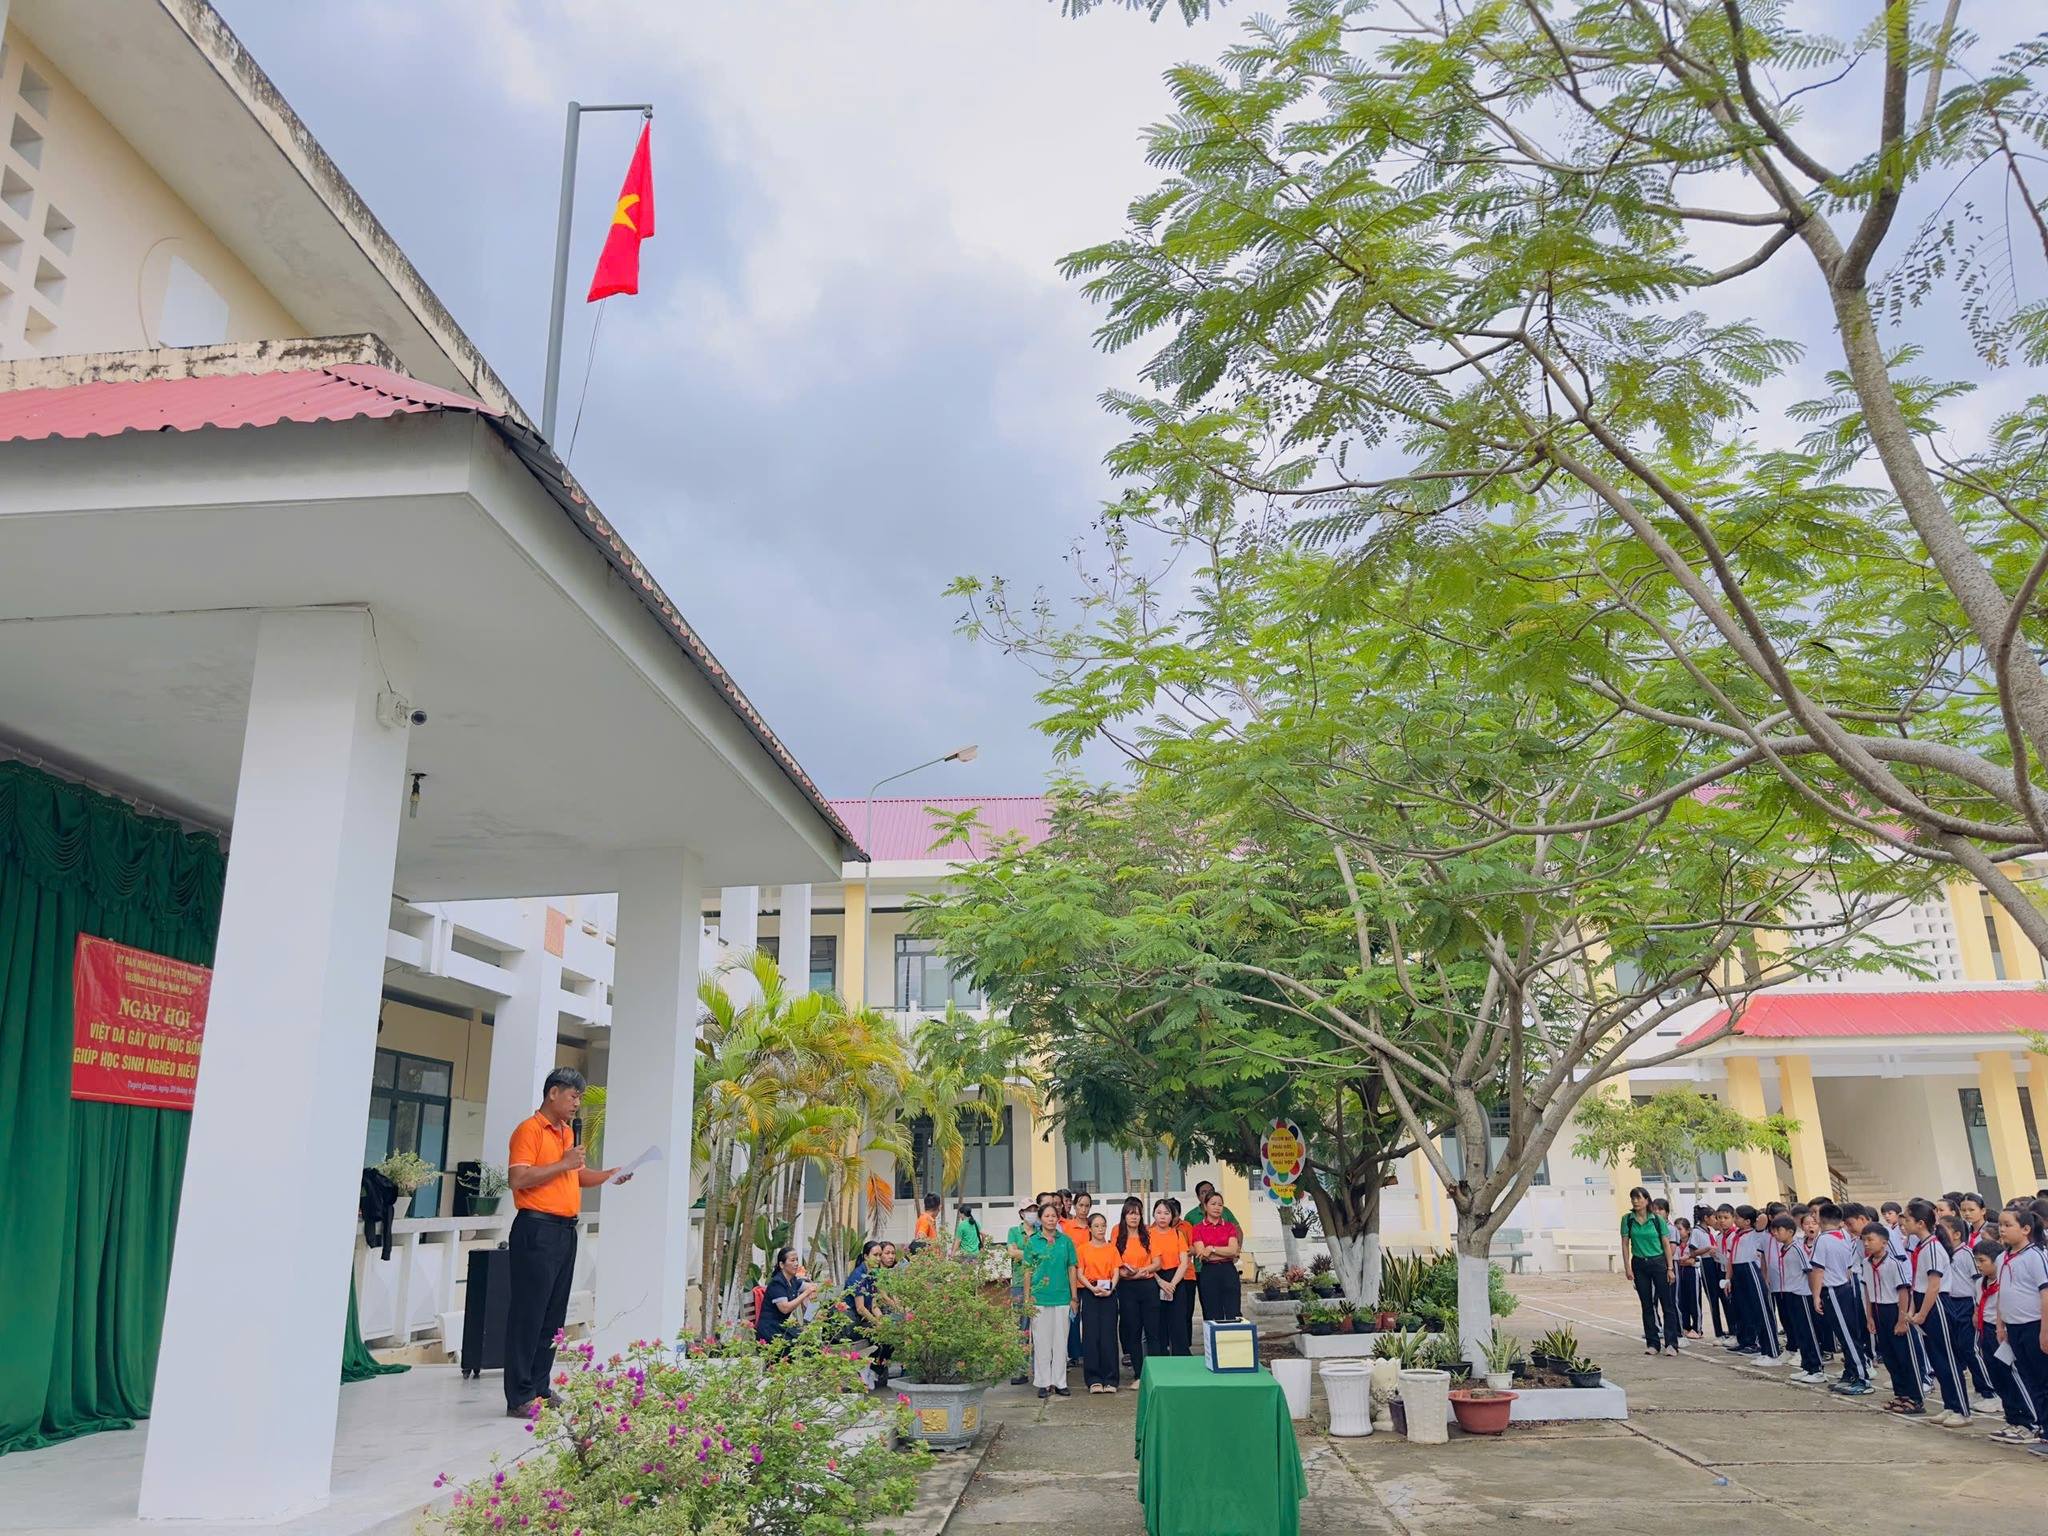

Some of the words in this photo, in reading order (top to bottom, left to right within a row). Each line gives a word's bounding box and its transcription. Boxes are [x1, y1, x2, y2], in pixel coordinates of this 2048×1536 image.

[117, 997, 162, 1022] NGÀY
[164, 1006, 192, 1031] HỘI
[90, 1021, 111, 1044] VIỆT
[128, 1028, 147, 1046] GÂY
[148, 1033, 167, 1050] QUỸ
[167, 1036, 185, 1055] HỌC
[73, 1045, 98, 1064] GIÚP
[100, 1052, 120, 1071] HỌC
[121, 1055, 145, 1072] SINH
[146, 1057, 175, 1076] NGHÈO
